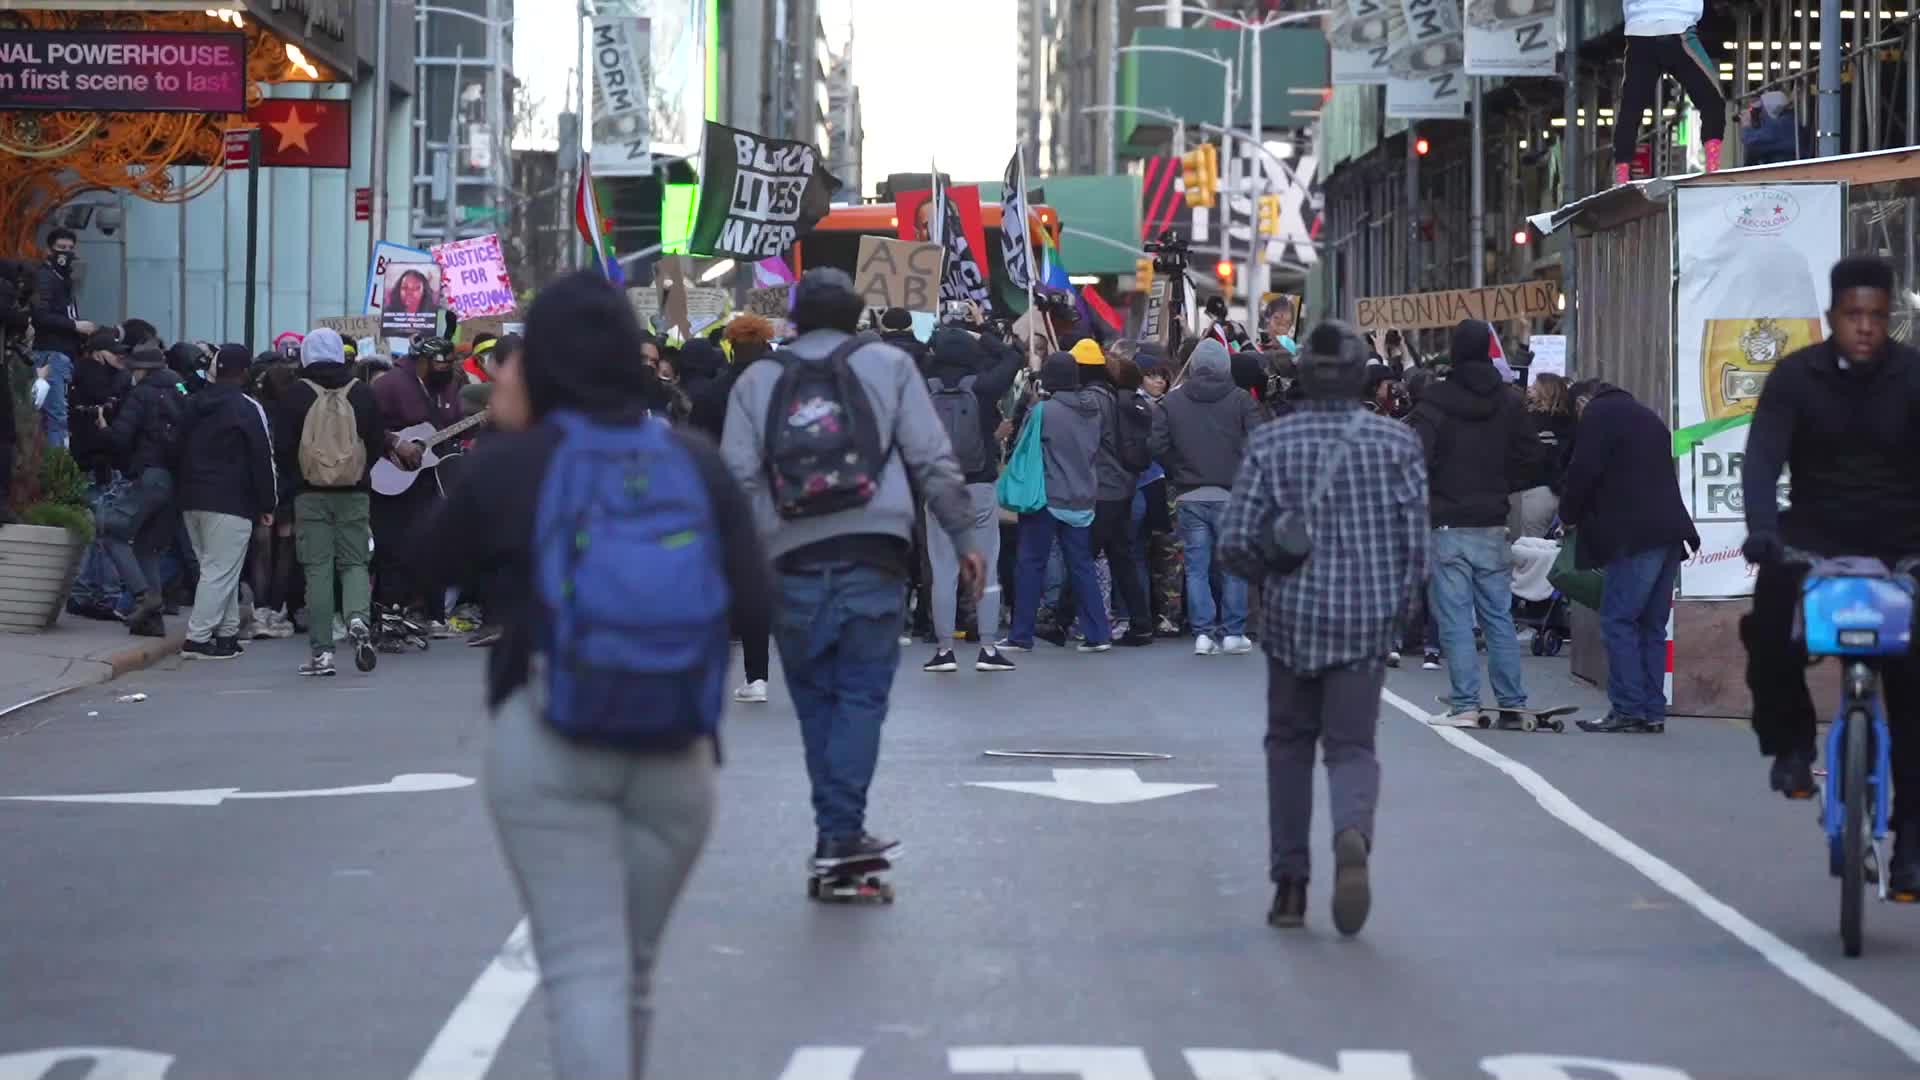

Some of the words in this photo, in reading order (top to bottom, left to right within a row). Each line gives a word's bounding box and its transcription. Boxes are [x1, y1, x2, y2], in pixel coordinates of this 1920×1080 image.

[48, 43, 235, 66] POWERHOUSE.
[20, 68, 69, 90] first
[75, 74, 149, 92] scene
[154, 71, 180, 92] to
[734, 133, 814, 175] BLACK
[734, 173, 803, 215] LIVES
[445, 245, 497, 269] JUSTICE
[460, 267, 488, 285] FOR
[454, 288, 513, 312] BREONNA
[1470, 282, 1557, 321] TAYLOR
